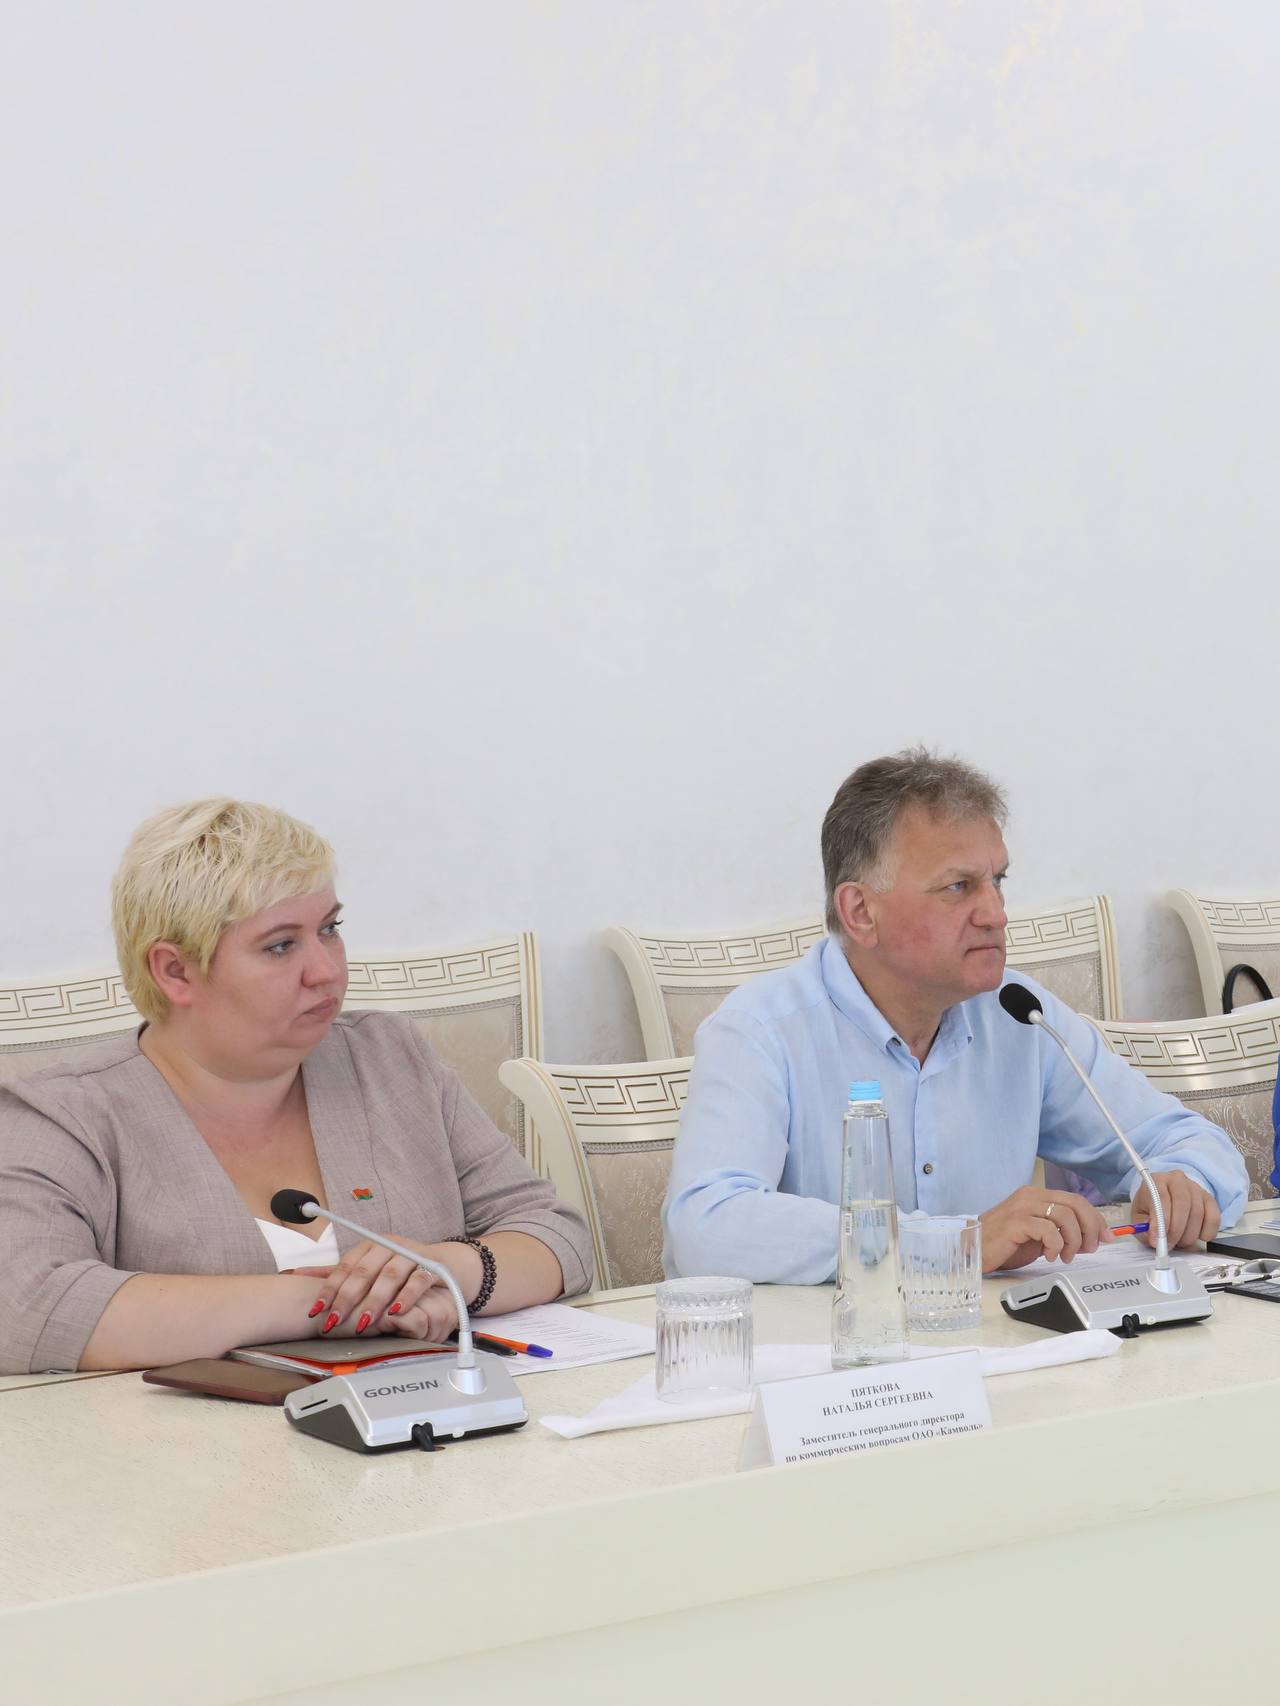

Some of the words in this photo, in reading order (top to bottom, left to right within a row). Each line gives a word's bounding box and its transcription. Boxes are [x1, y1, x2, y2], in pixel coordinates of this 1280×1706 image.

[1081, 1278, 1141, 1293] GONSIN
[364, 1379, 439, 1398] GONSIN
[850, 1382, 901, 1398] ПЯТКОВА
[822, 1400, 873, 1417] НАТАЛЬЯ
[874, 1390, 934, 1408] СЕРГЕЕВНА
[799, 1428, 858, 1447] Заместитель
[859, 1419, 919, 1437] генерального
[920, 1411, 965, 1427] директора
[785, 1454, 797, 1464] по
[799, 1443, 867, 1461] коммерческим
[868, 1434, 910, 1449] вопросам
[911, 1428, 934, 1441] ОАО
[935, 1423, 984, 1437] «Камволь»
